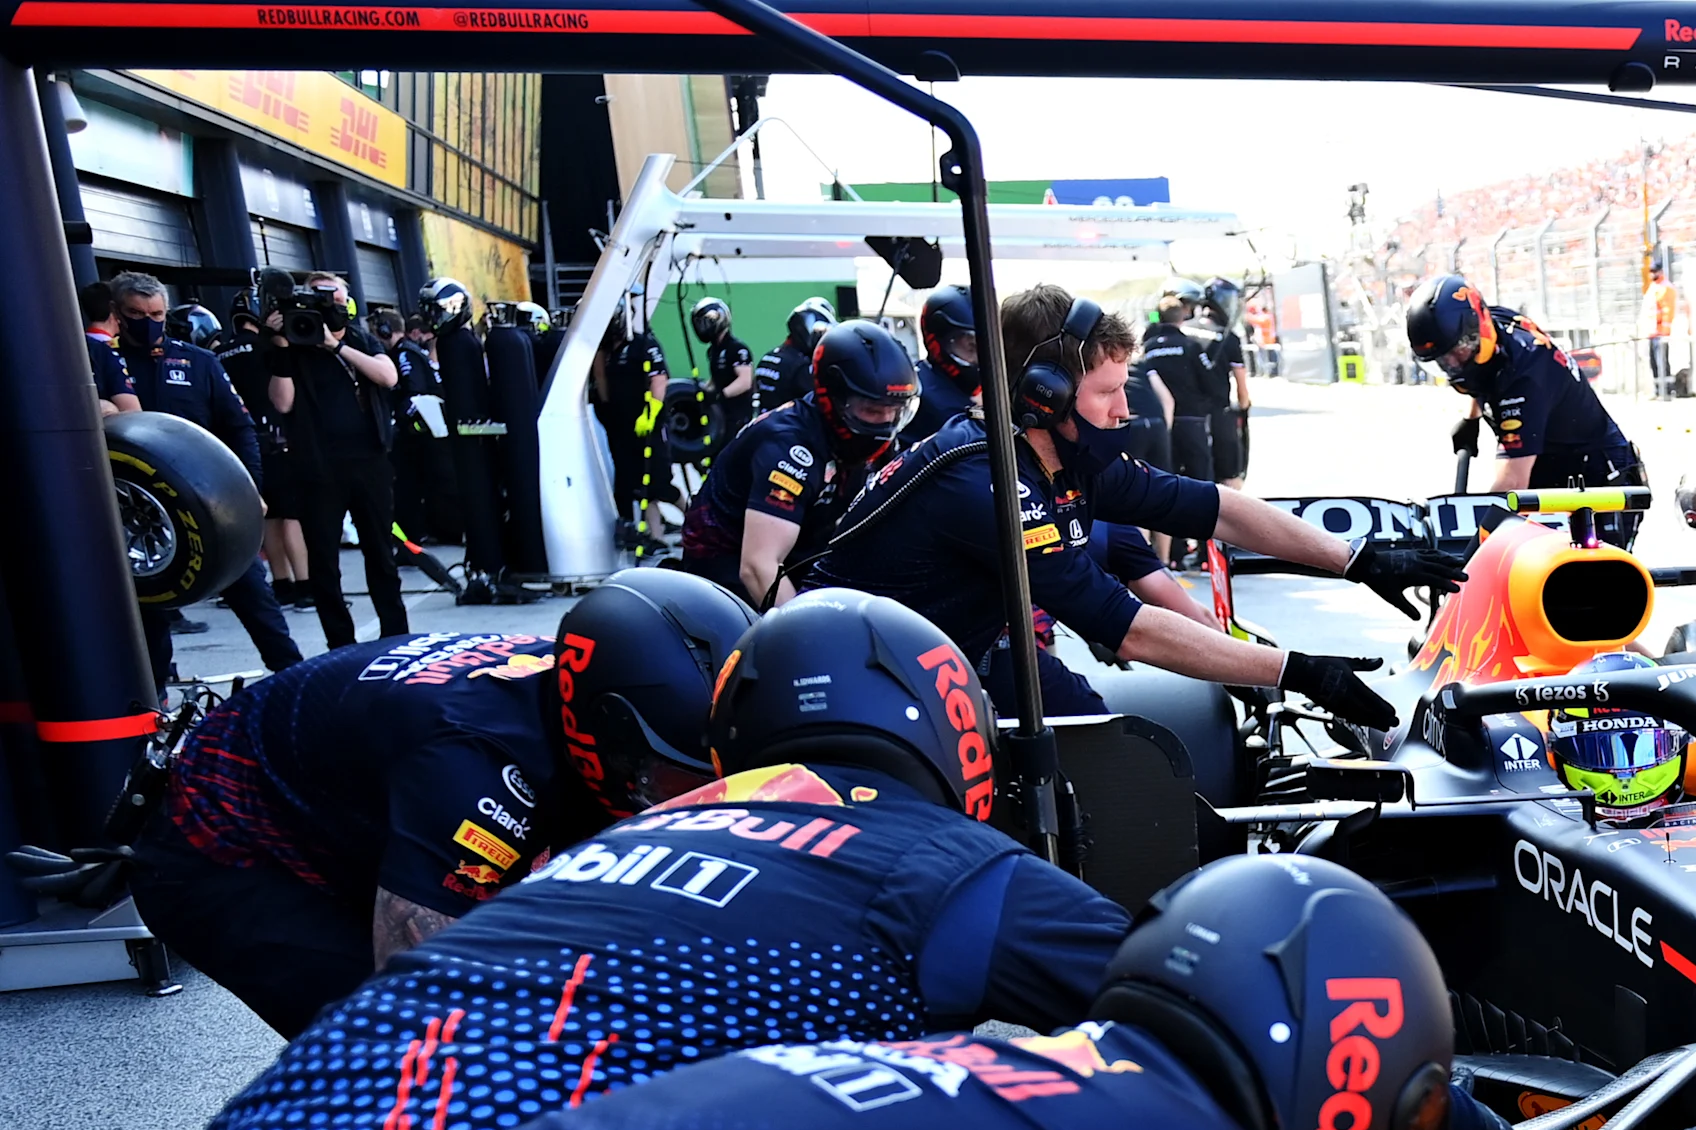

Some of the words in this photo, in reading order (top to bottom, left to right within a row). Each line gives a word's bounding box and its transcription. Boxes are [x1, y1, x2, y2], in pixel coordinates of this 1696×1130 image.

[257, 8, 421, 27] REDBULLRACING.COM
[453, 11, 589, 29] @REDBULLRACING
[333, 97, 385, 167] DHL
[152, 481, 179, 499] P
[175, 508, 205, 592] ZERO
[1532, 684, 1587, 701] Tezos
[916, 643, 994, 782] Red
[1582, 716, 1660, 733] HONDA
[1503, 758, 1542, 771] INTER
[509, 769, 535, 800] Esso
[1619, 791, 1646, 803] INTER
[477, 796, 529, 840] Claro
[462, 826, 515, 867] PIRELLI
[1513, 838, 1655, 969] ORACLE
